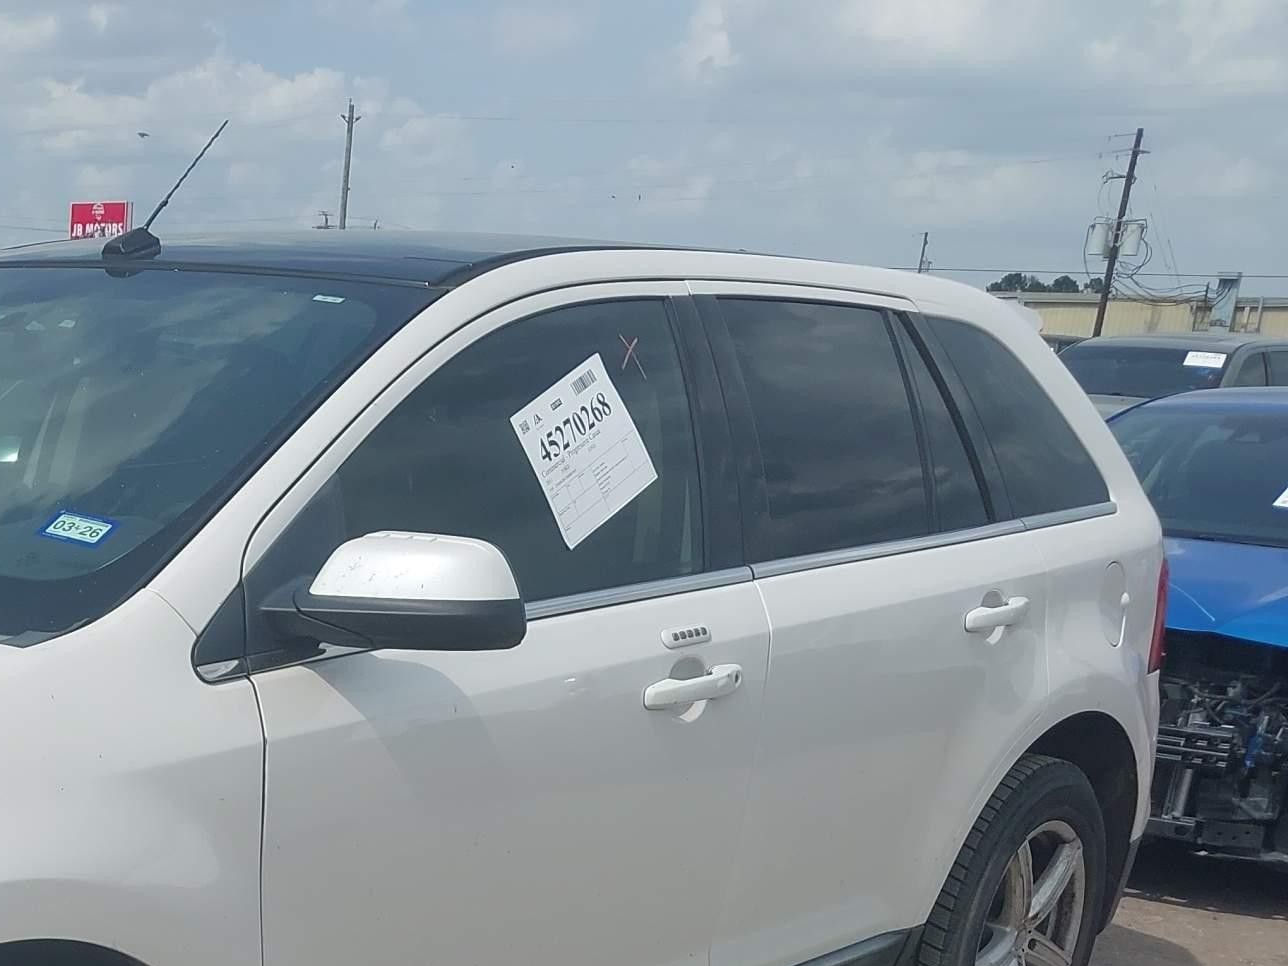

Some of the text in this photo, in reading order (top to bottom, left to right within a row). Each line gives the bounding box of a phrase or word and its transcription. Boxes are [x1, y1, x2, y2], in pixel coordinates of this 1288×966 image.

[71, 222, 123, 238] JB MOTORS
[540, 392, 612, 461] 45270268
